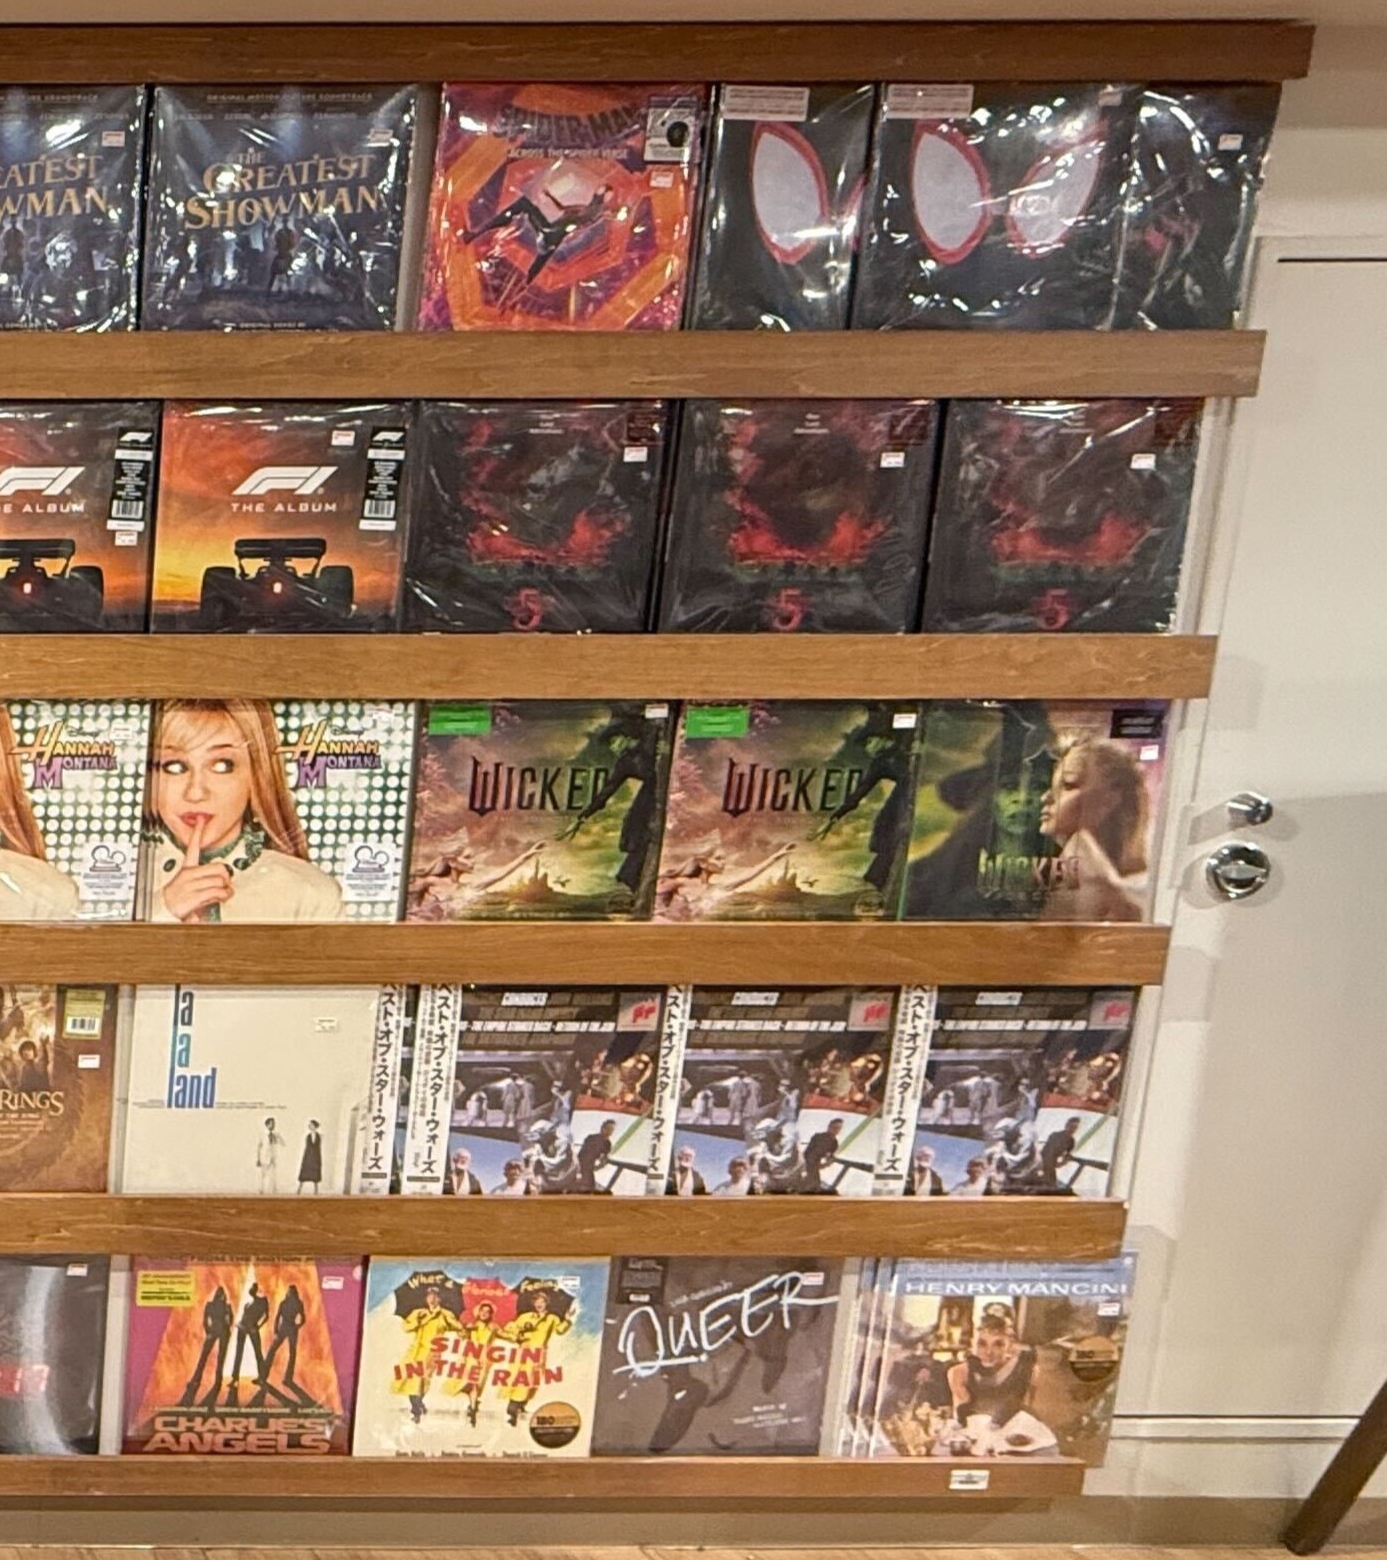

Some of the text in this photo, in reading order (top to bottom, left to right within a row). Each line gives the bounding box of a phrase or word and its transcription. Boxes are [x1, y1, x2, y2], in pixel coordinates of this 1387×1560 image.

[203, 154, 377, 193] GREATEST
[185, 185, 379, 230] SHOWMAN
[231, 466, 338, 496] F1
[22, 503, 85, 513] ALBUM
[231, 502, 337, 512] THE ALBUM
[511, 588, 542, 630] 5
[772, 588, 803, 630] 5
[1037, 588, 1070, 630] 5
[10, 720, 117, 766] HANNAH
[274, 718, 380, 764] HANNAH
[33, 756, 119, 790] MONTANA
[296, 755, 383, 789] MONTANA
[469, 756, 612, 818] WICKED
[721, 758, 863, 818] WICKED
[167, 1067, 217, 1109] land
[906, 1281, 1127, 1295] HENRY MANCINI
[615, 1270, 840, 1376] QUEER
[430, 1337, 543, 1364] SINGIN
[393, 1359, 564, 1388] IN THE RAIN
[142, 1432, 331, 1454] ANGELS
[154, 1416, 326, 1433] CHARLIE'S
